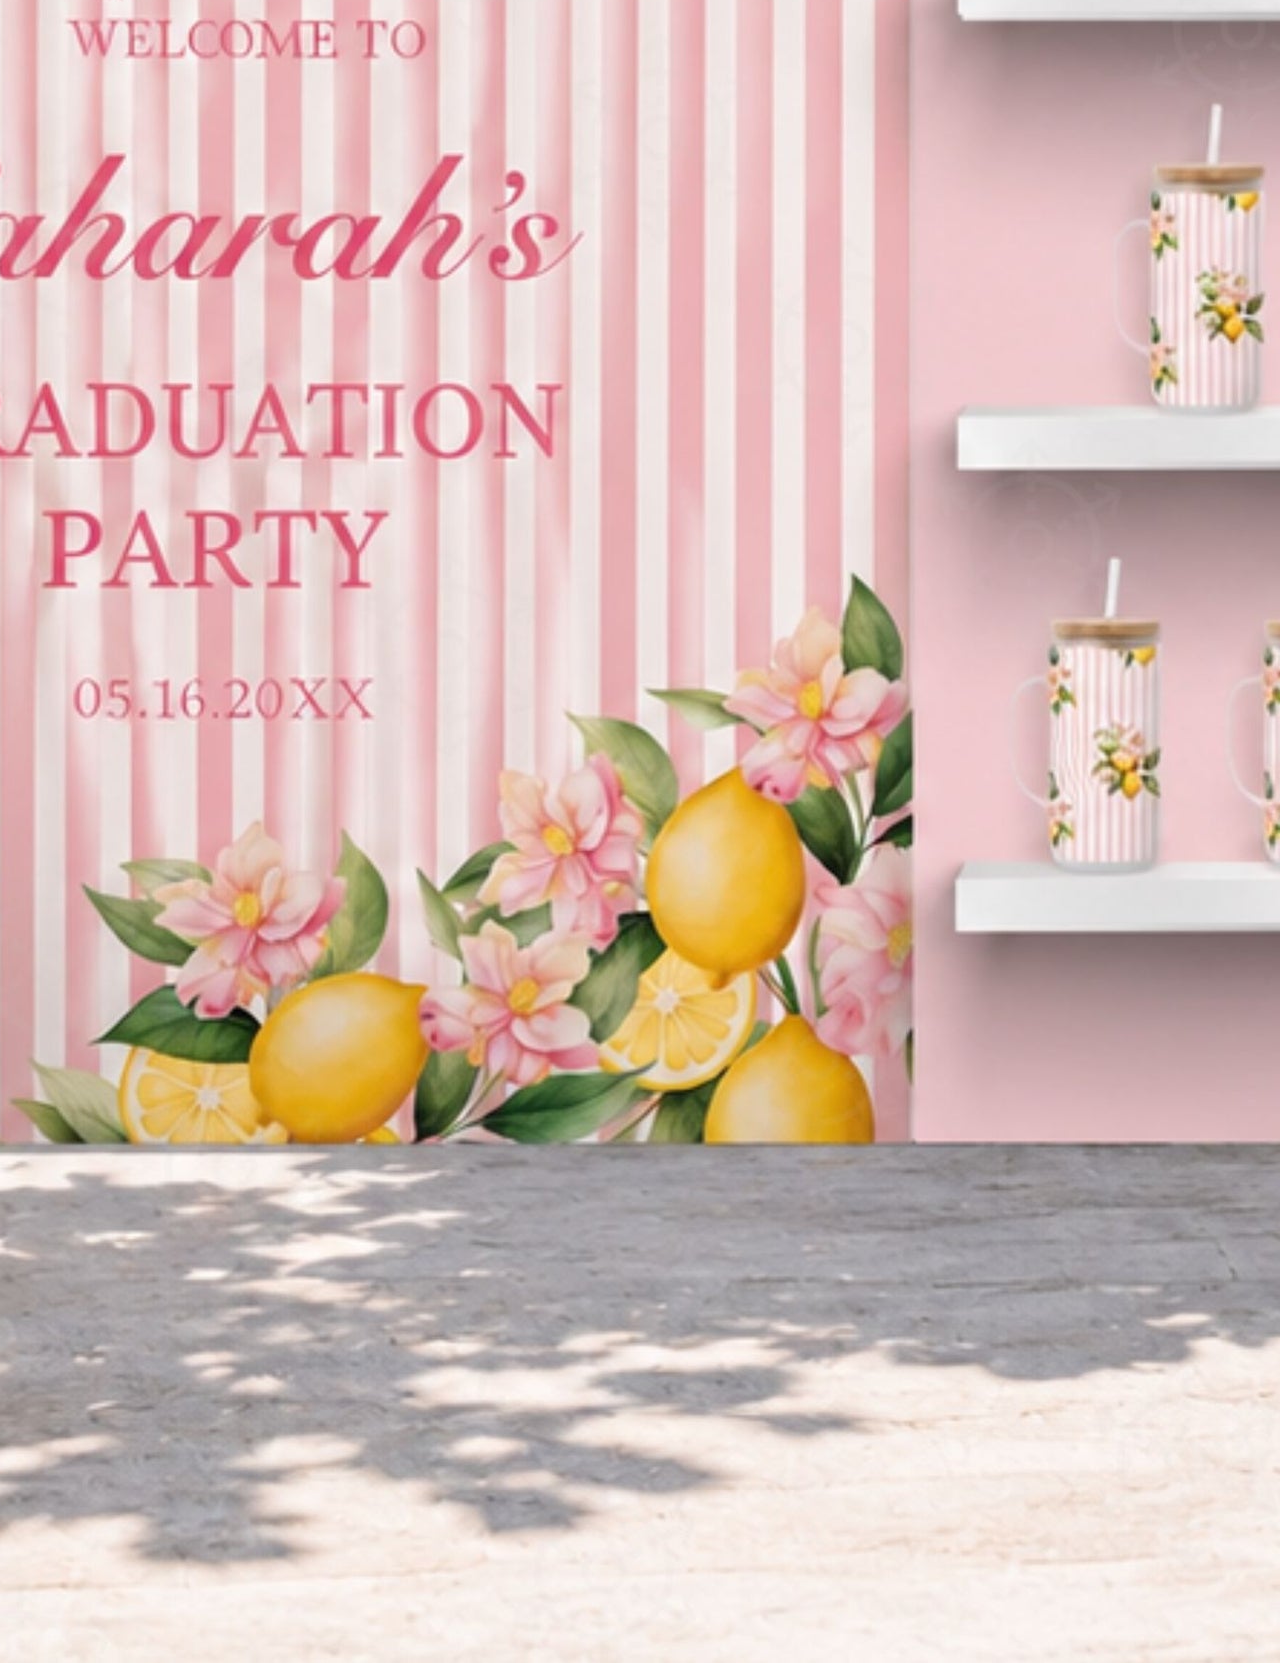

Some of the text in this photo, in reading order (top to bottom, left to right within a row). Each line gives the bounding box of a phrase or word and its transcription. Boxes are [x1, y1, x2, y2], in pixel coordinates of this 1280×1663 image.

[70, 20, 426, 59] WELCOME TO
[42, 510, 389, 589] PARTY
[74, 678, 374, 720] 05.16.20XX
